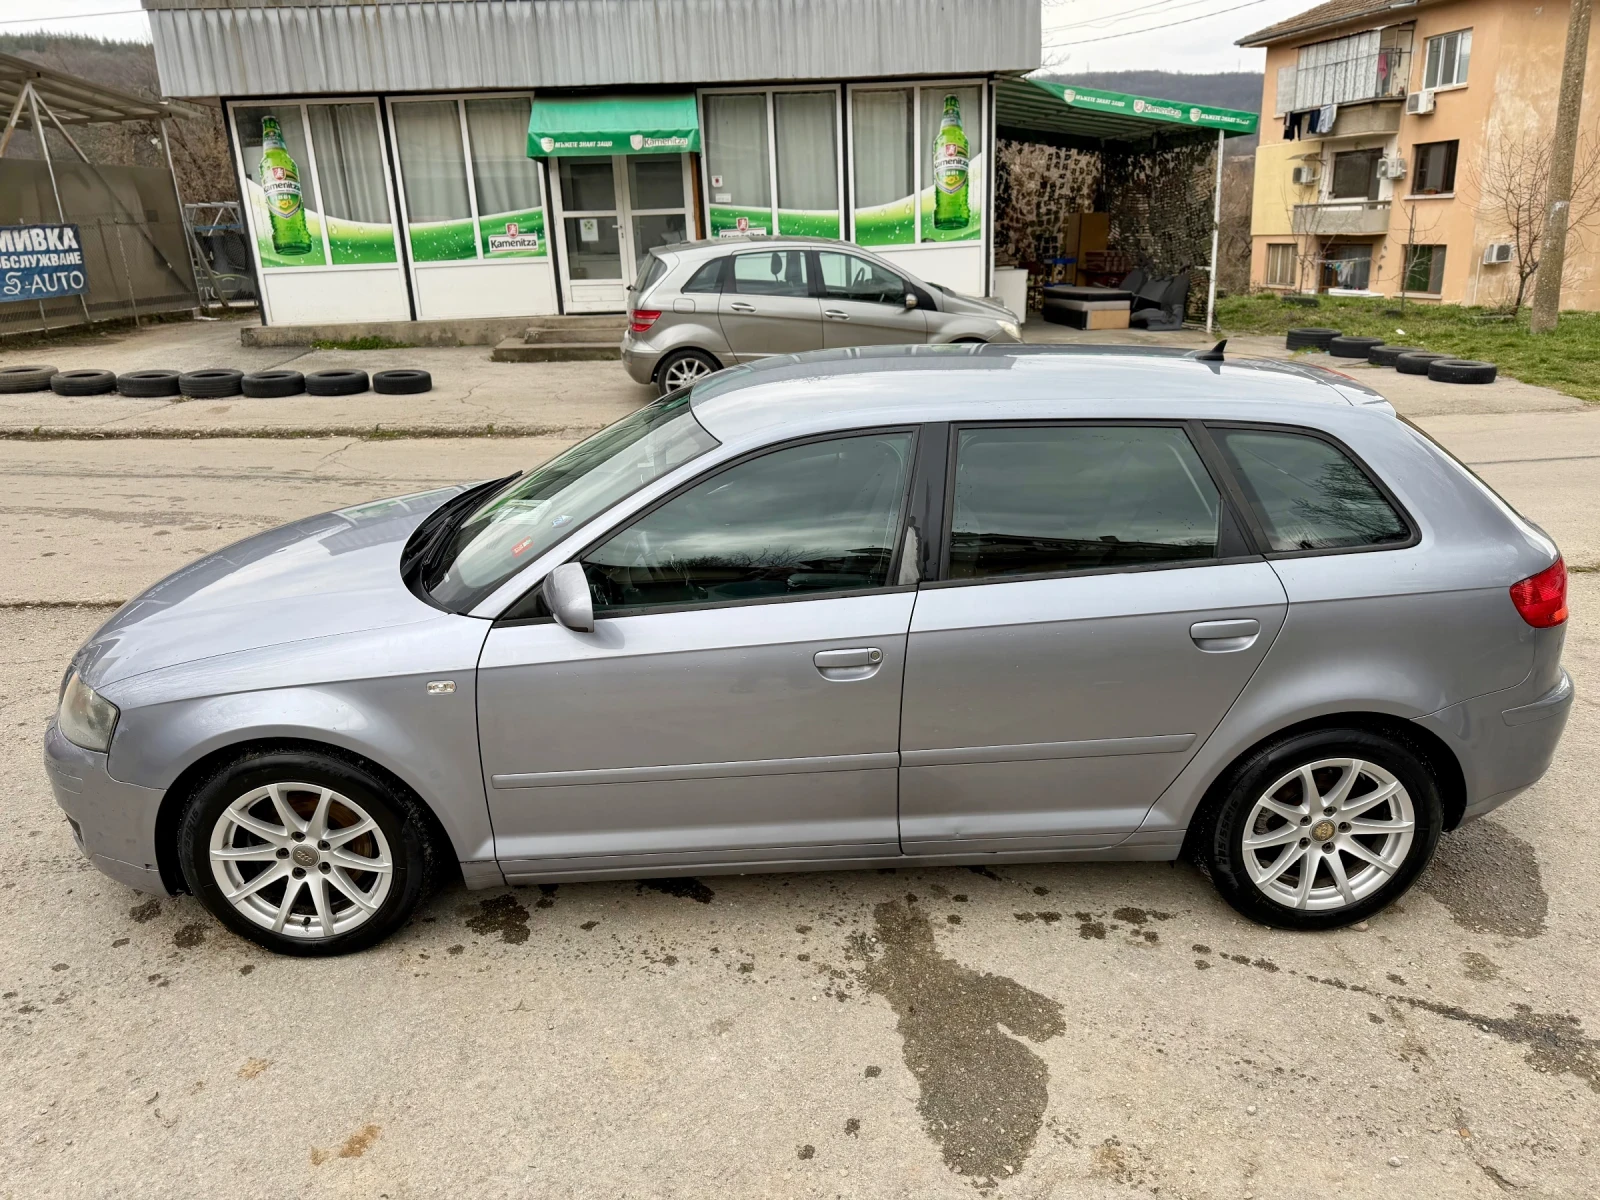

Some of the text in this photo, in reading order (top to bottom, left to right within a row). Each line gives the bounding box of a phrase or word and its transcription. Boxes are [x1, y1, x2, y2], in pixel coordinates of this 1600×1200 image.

[1144, 103, 1182, 117] Kamenitza
[645, 137, 687, 147] Kamenitza
[491, 238, 537, 249] Kamenitza
[0, 252, 82, 269] БСЛУЖВАНЕ
